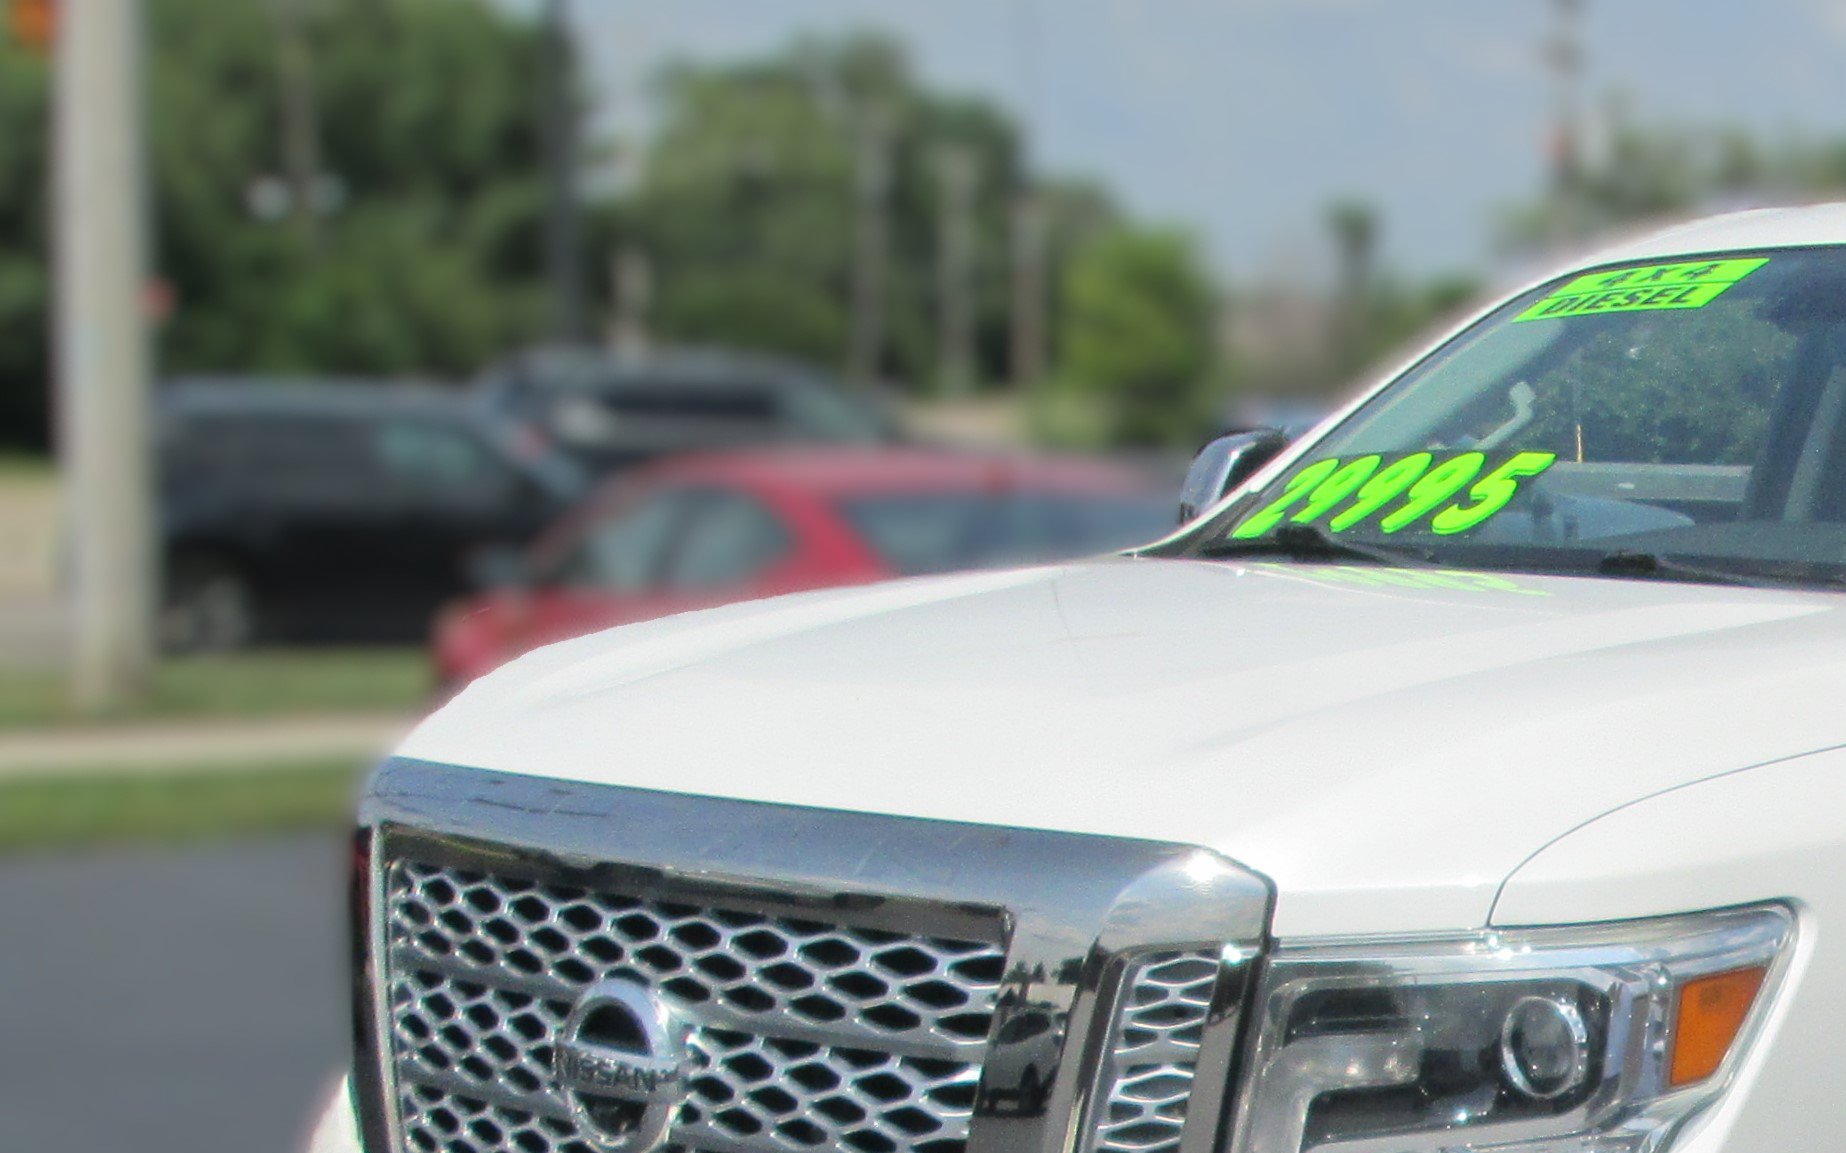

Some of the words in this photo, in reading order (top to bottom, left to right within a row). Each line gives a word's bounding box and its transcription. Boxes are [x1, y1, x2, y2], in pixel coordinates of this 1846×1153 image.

[1539, 286, 1699, 316] DIESEL
[1232, 452, 1557, 539] 29995
[558, 1046, 656, 1092] NISSAN
